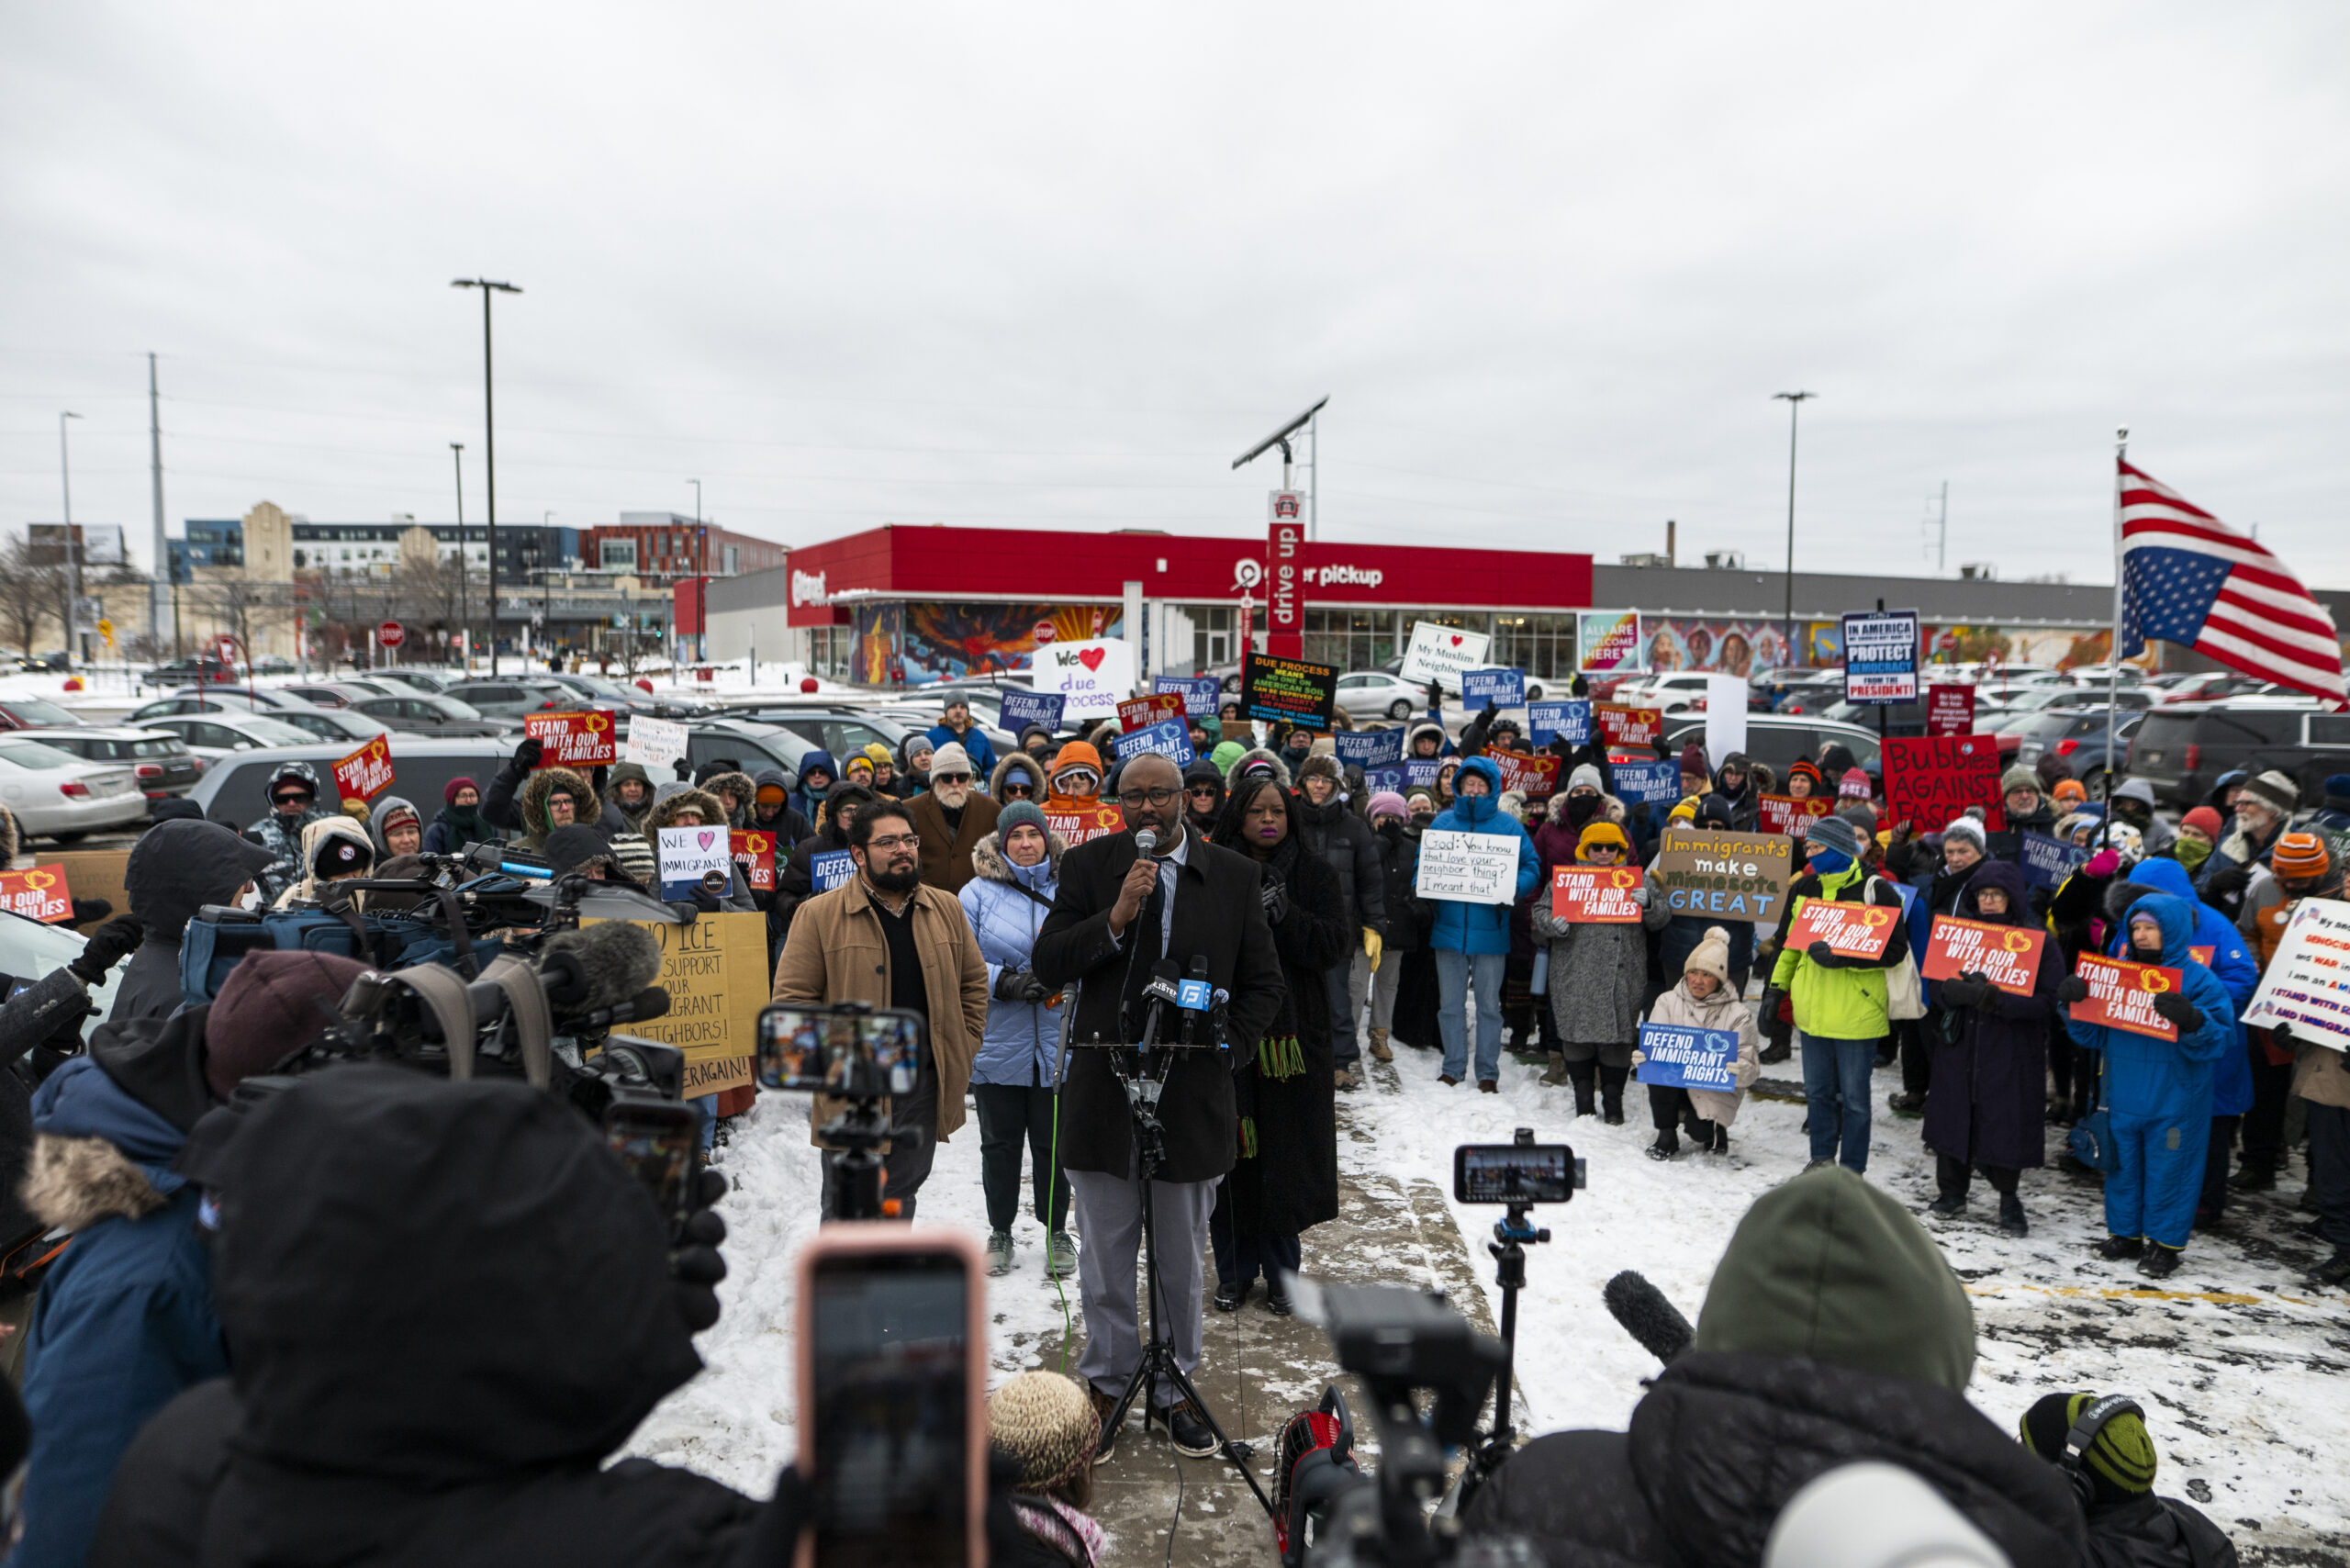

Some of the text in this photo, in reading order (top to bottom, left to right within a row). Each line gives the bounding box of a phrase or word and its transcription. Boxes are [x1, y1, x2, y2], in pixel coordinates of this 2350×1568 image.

[1273, 528, 1299, 624] drive up
[1319, 564, 1383, 589] pickup
[379, 629, 401, 640] STOP
[1035, 628, 1056, 639] STOP
[1584, 623, 1635, 636] ALL ARE
[1848, 622, 1911, 634] IN AMERICA
[1436, 633, 1441, 644] I
[1584, 636, 1635, 647] WELCOME
[1056, 650, 1080, 666] We
[1416, 644, 1474, 664] My Muslim
[1584, 647, 1621, 660] HERE
[1848, 644, 1912, 662] PROTECT
[1255, 656, 1330, 676] DUE PROCESS
[1274, 668, 1304, 678] MEANS
[1849, 660, 1913, 674] DEMOCRACY
[1059, 673, 1096, 692] due
[1158, 682, 1192, 695] DEFEND
[1254, 678, 1303, 692] AMERICAN
[1464, 676, 1497, 687] DEFEND
[1253, 685, 1268, 693] CAN
[1279, 689, 1313, 700] DEPRIVED
[1470, 684, 1517, 697] IMMIGRANT
[1850, 684, 1914, 697] PRESIDENT!
[1004, 695, 1040, 710] DEFEND
[1064, 692, 1114, 708] rocess
[1273, 701, 1313, 713] PROPERTY
[1492, 694, 1522, 705] RIGHTS
[1008, 707, 1058, 721] IMMIGRANT
[1121, 702, 1149, 718] STAND
[1132, 711, 1154, 724] WITH
[1157, 709, 1174, 719] OUR
[1186, 703, 1216, 714] RIGHTS
[1250, 705, 1281, 714] WITHOUT
[1282, 710, 1296, 718] THE
[1530, 708, 1561, 720] DEFEND
[1600, 711, 1627, 722] STAND
[530, 720, 569, 736] STAND
[1535, 718, 1583, 731] IMMIGRANT
[1608, 722, 1650, 734] WITH OUR
[543, 732, 600, 749] WITH OUR
[628, 738, 643, 750] NOT
[1118, 734, 1154, 757] DEFEND
[1337, 736, 1375, 748] DEFEND
[1619, 733, 1658, 745] FAMILIE
[558, 744, 612, 761] FAMILIES
[1343, 743, 1396, 759] IMMIGRANT
[1888, 739, 1998, 773] Bubbies
[1367, 752, 1400, 767] RIGHTS
[1490, 751, 1520, 770] STAND
[338, 756, 364, 783] STAND
[351, 757, 383, 790] WITH OUR
[1408, 766, 1438, 777] DEFEN
[1522, 772, 1544, 783] OUR
[1614, 769, 1648, 780] DEFEND
[363, 764, 393, 797] FAMILIES
[1505, 779, 1552, 792] FAMILIES
[1620, 778, 1673, 791] IMMIGRANT
[1893, 773, 2001, 801] AGAINST
[1643, 787, 1678, 801] RIGHTS
[1762, 800, 1792, 815] STAND
[1771, 813, 1796, 825] WITH
[661, 834, 687, 848] WE
[1424, 833, 1460, 851] God:
[1487, 837, 1512, 854] know
[1665, 833, 1790, 859] Immigrants
[2024, 838, 2061, 860] DEFEND
[662, 857, 729, 874] IMMIGRANTS
[1425, 851, 1495, 867] that love your
[2028, 852, 2076, 875] IMMIGRA
[1424, 864, 1466, 878] neighbor
[1695, 858, 1758, 877] make
[1423, 877, 1463, 892] I meant
[1556, 873, 1595, 888] STAND
[15, 889, 47, 908] OUR
[1568, 887, 1626, 902] WITH OUR
[1669, 889, 1774, 915] GREAT
[1583, 902, 1638, 916] FAMILIES
[1802, 905, 1846, 923] STAND
[1809, 920, 1874, 939] WITH OUR
[1955, 919, 1971, 927] WITH
[2319, 917, 2333, 928] My
[678, 921, 716, 952] ICE
[1935, 924, 1983, 946] STAND
[2305, 934, 2350, 951] GENOCID
[1822, 934, 1883, 953] FAMILIES
[1946, 942, 2018, 968] WITH OUR
[2093, 956, 2106, 964] WITH
[2106, 958, 2141, 970] IMMIGRANTS
[2295, 953, 2339, 969] and WAR
[663, 955, 722, 977] SUPPORT
[1963, 960, 2030, 986] FAMILIES
[2077, 961, 2120, 985] STAND
[662, 979, 690, 995] OUR
[2295, 973, 2309, 982] am
[2311, 978, 2326, 987] an
[2088, 981, 2156, 1009] WITH OUR
[2276, 988, 2340, 1011] STAND WITH
[665, 994, 723, 1017] IGRANT
[2106, 1002, 2171, 1030] FAMILIES
[2275, 1007, 2350, 1037] AND IMMIGRA
[1643, 1031, 1694, 1049] DEFEND
[1650, 1047, 1726, 1068] IMMIGRANT
[1683, 1065, 1730, 1083] RIGHTS
